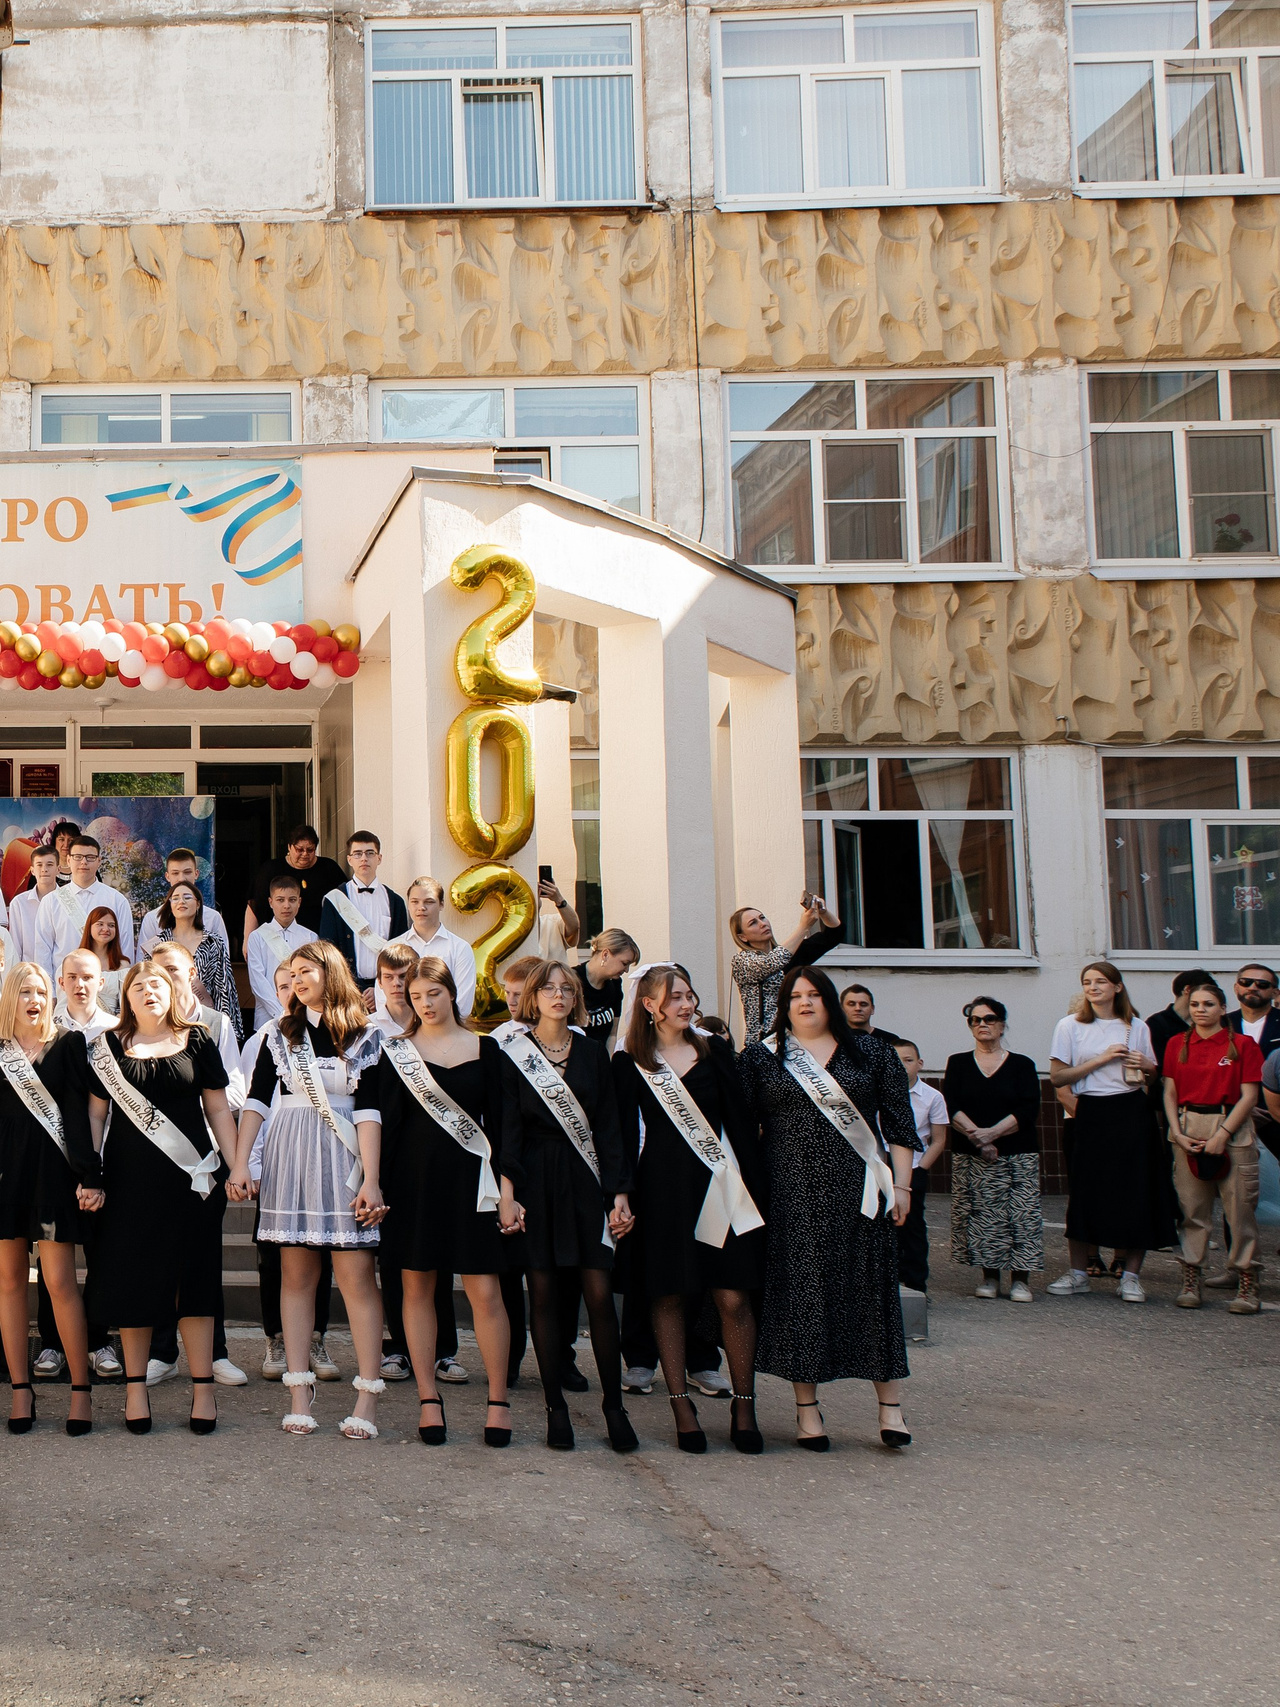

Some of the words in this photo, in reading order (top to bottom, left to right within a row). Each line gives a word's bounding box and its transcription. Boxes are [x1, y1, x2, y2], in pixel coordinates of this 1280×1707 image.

[210, 785, 238, 796] ВХОД
[1, 1052, 55, 1121] Выпускница
[92, 1048, 141, 1114] Выпускница
[394, 1052, 451, 1122] Выпускник
[451, 1115, 478, 1140] 2025
[535, 1075, 590, 1151] Выпускник
[645, 1063, 700, 1139] Выпускник
[697, 1136, 726, 1163] 2025
[785, 1043, 833, 1105] Выпускник
[829, 1101, 859, 1126] 2025
